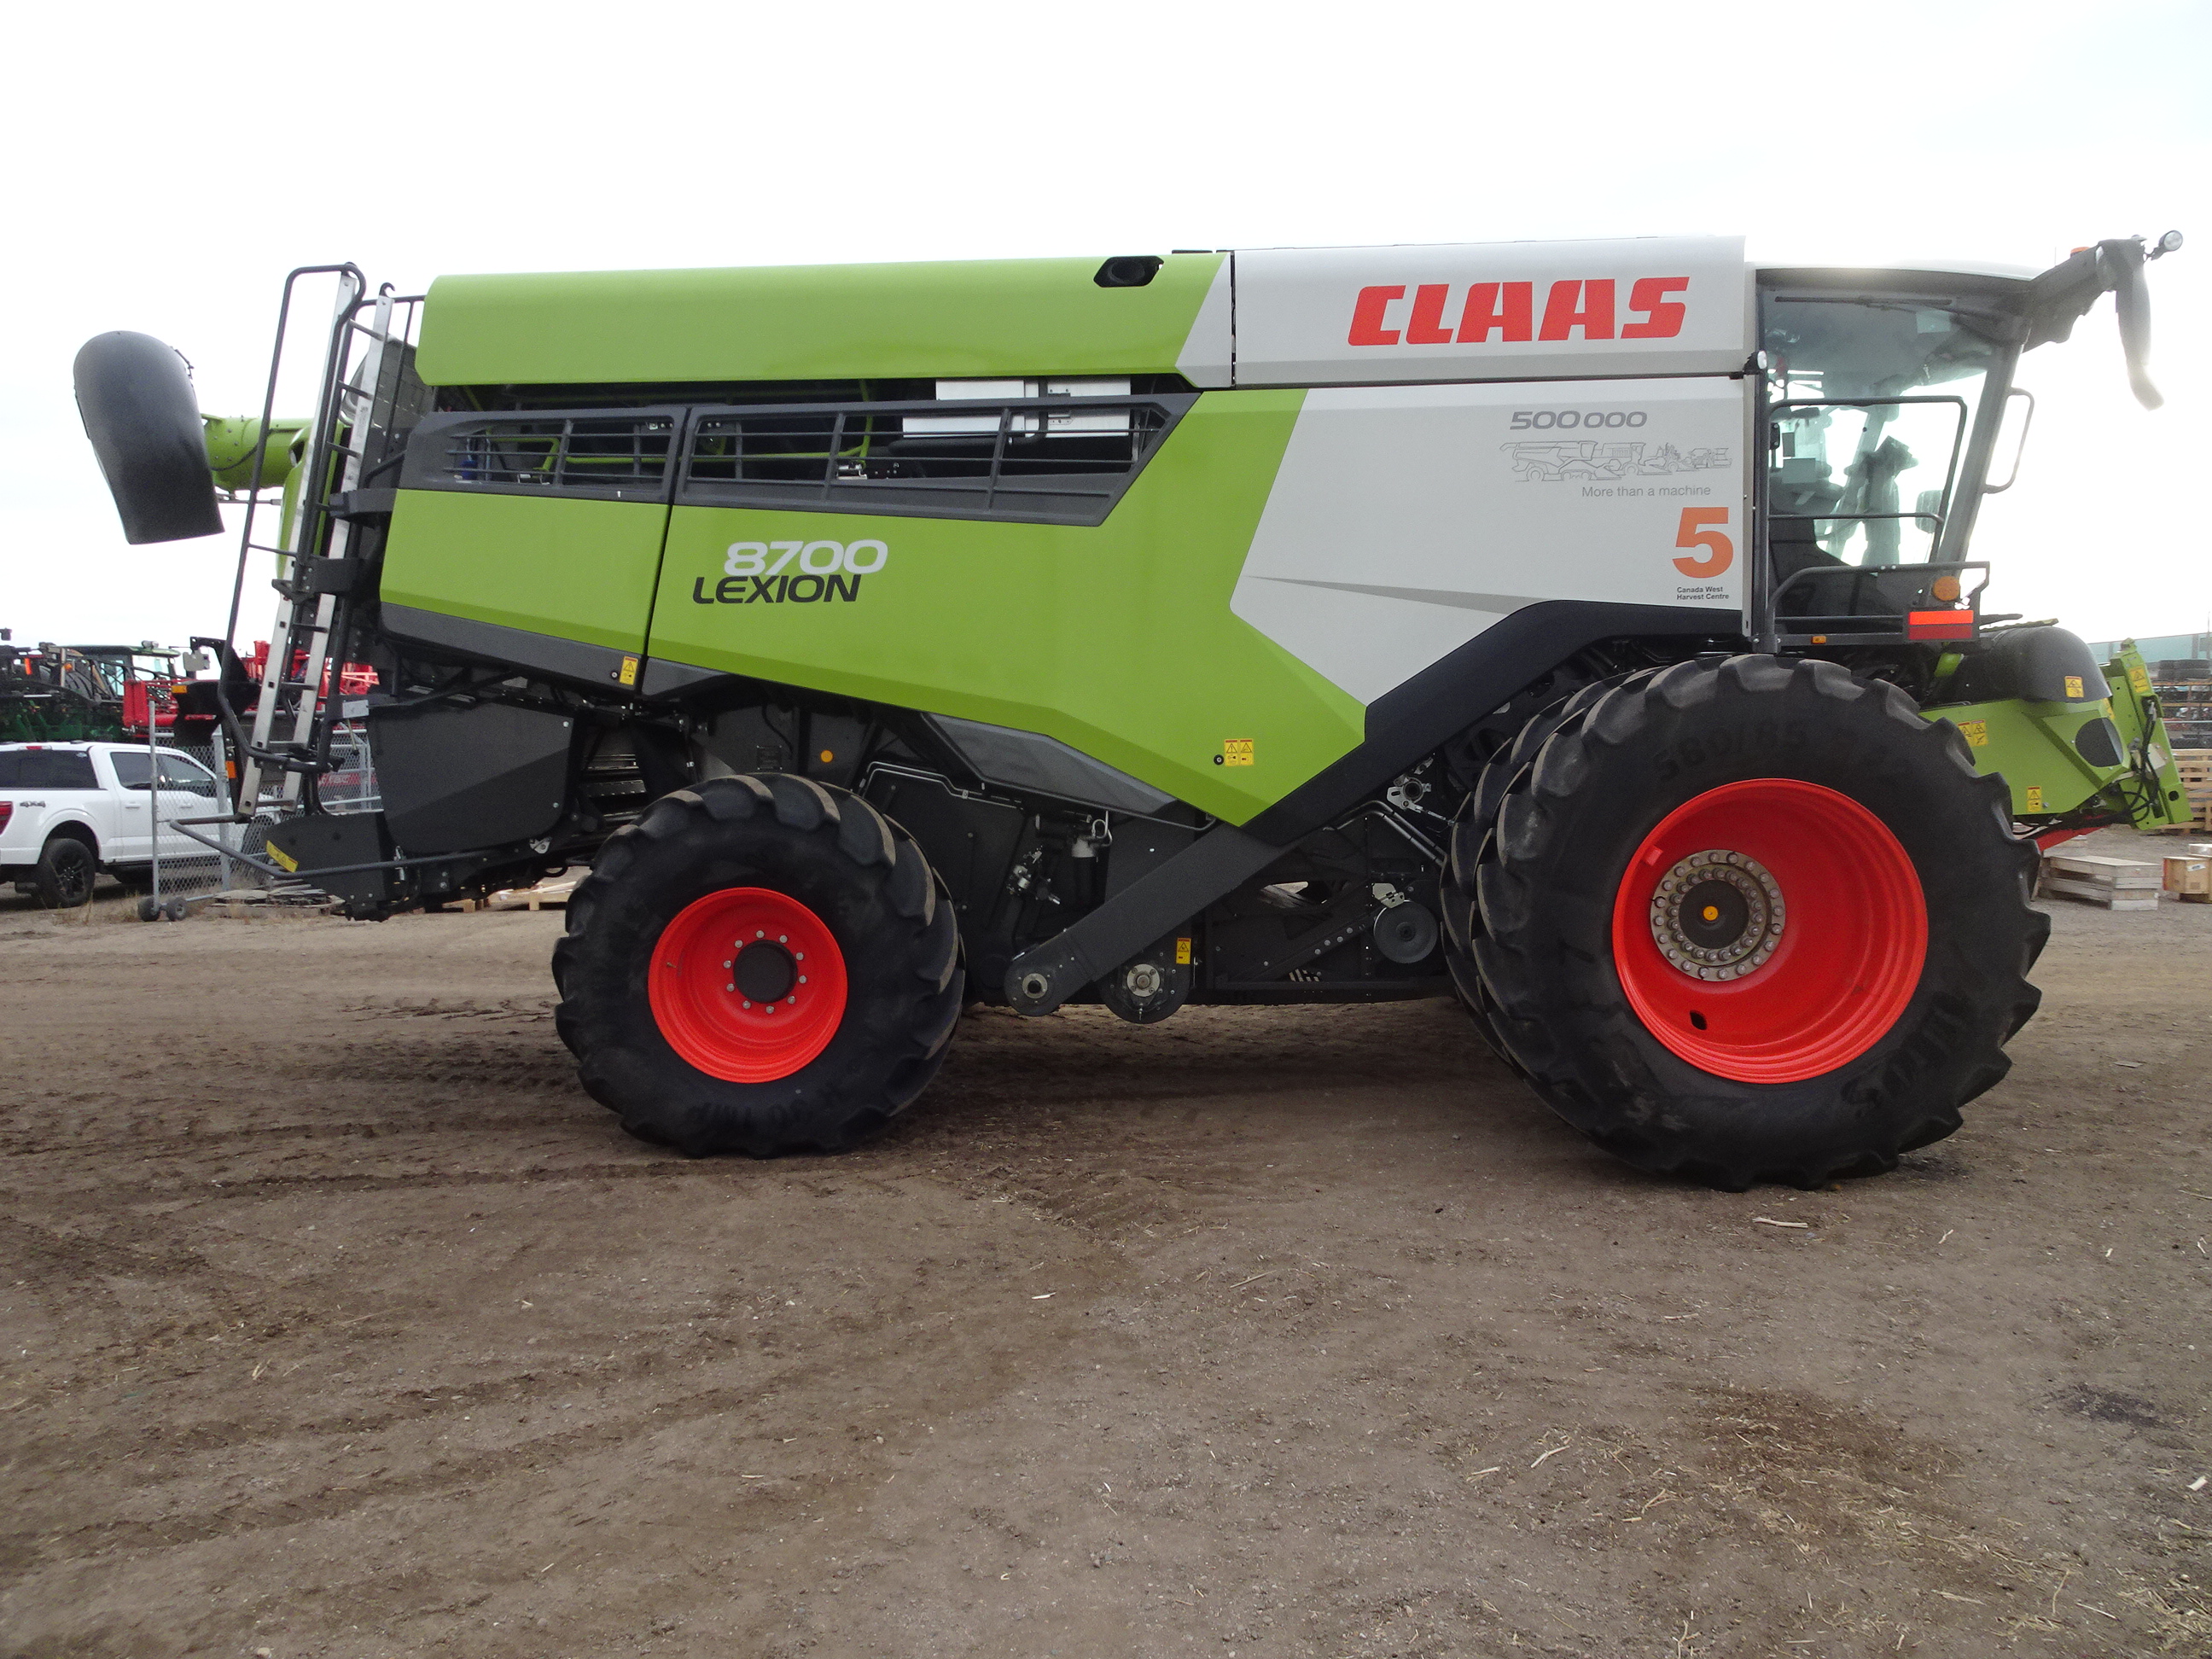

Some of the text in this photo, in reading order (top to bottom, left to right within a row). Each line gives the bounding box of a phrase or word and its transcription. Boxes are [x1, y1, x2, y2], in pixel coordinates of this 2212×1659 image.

[1348, 276, 1690, 346] CLAAS
[1510, 410, 1648, 430] 500 000
[1581, 486, 1711, 497] More than a machine
[724, 539, 888, 576] 8700
[1672, 506, 1734, 579] 5
[692, 574, 862, 604] LEXION
